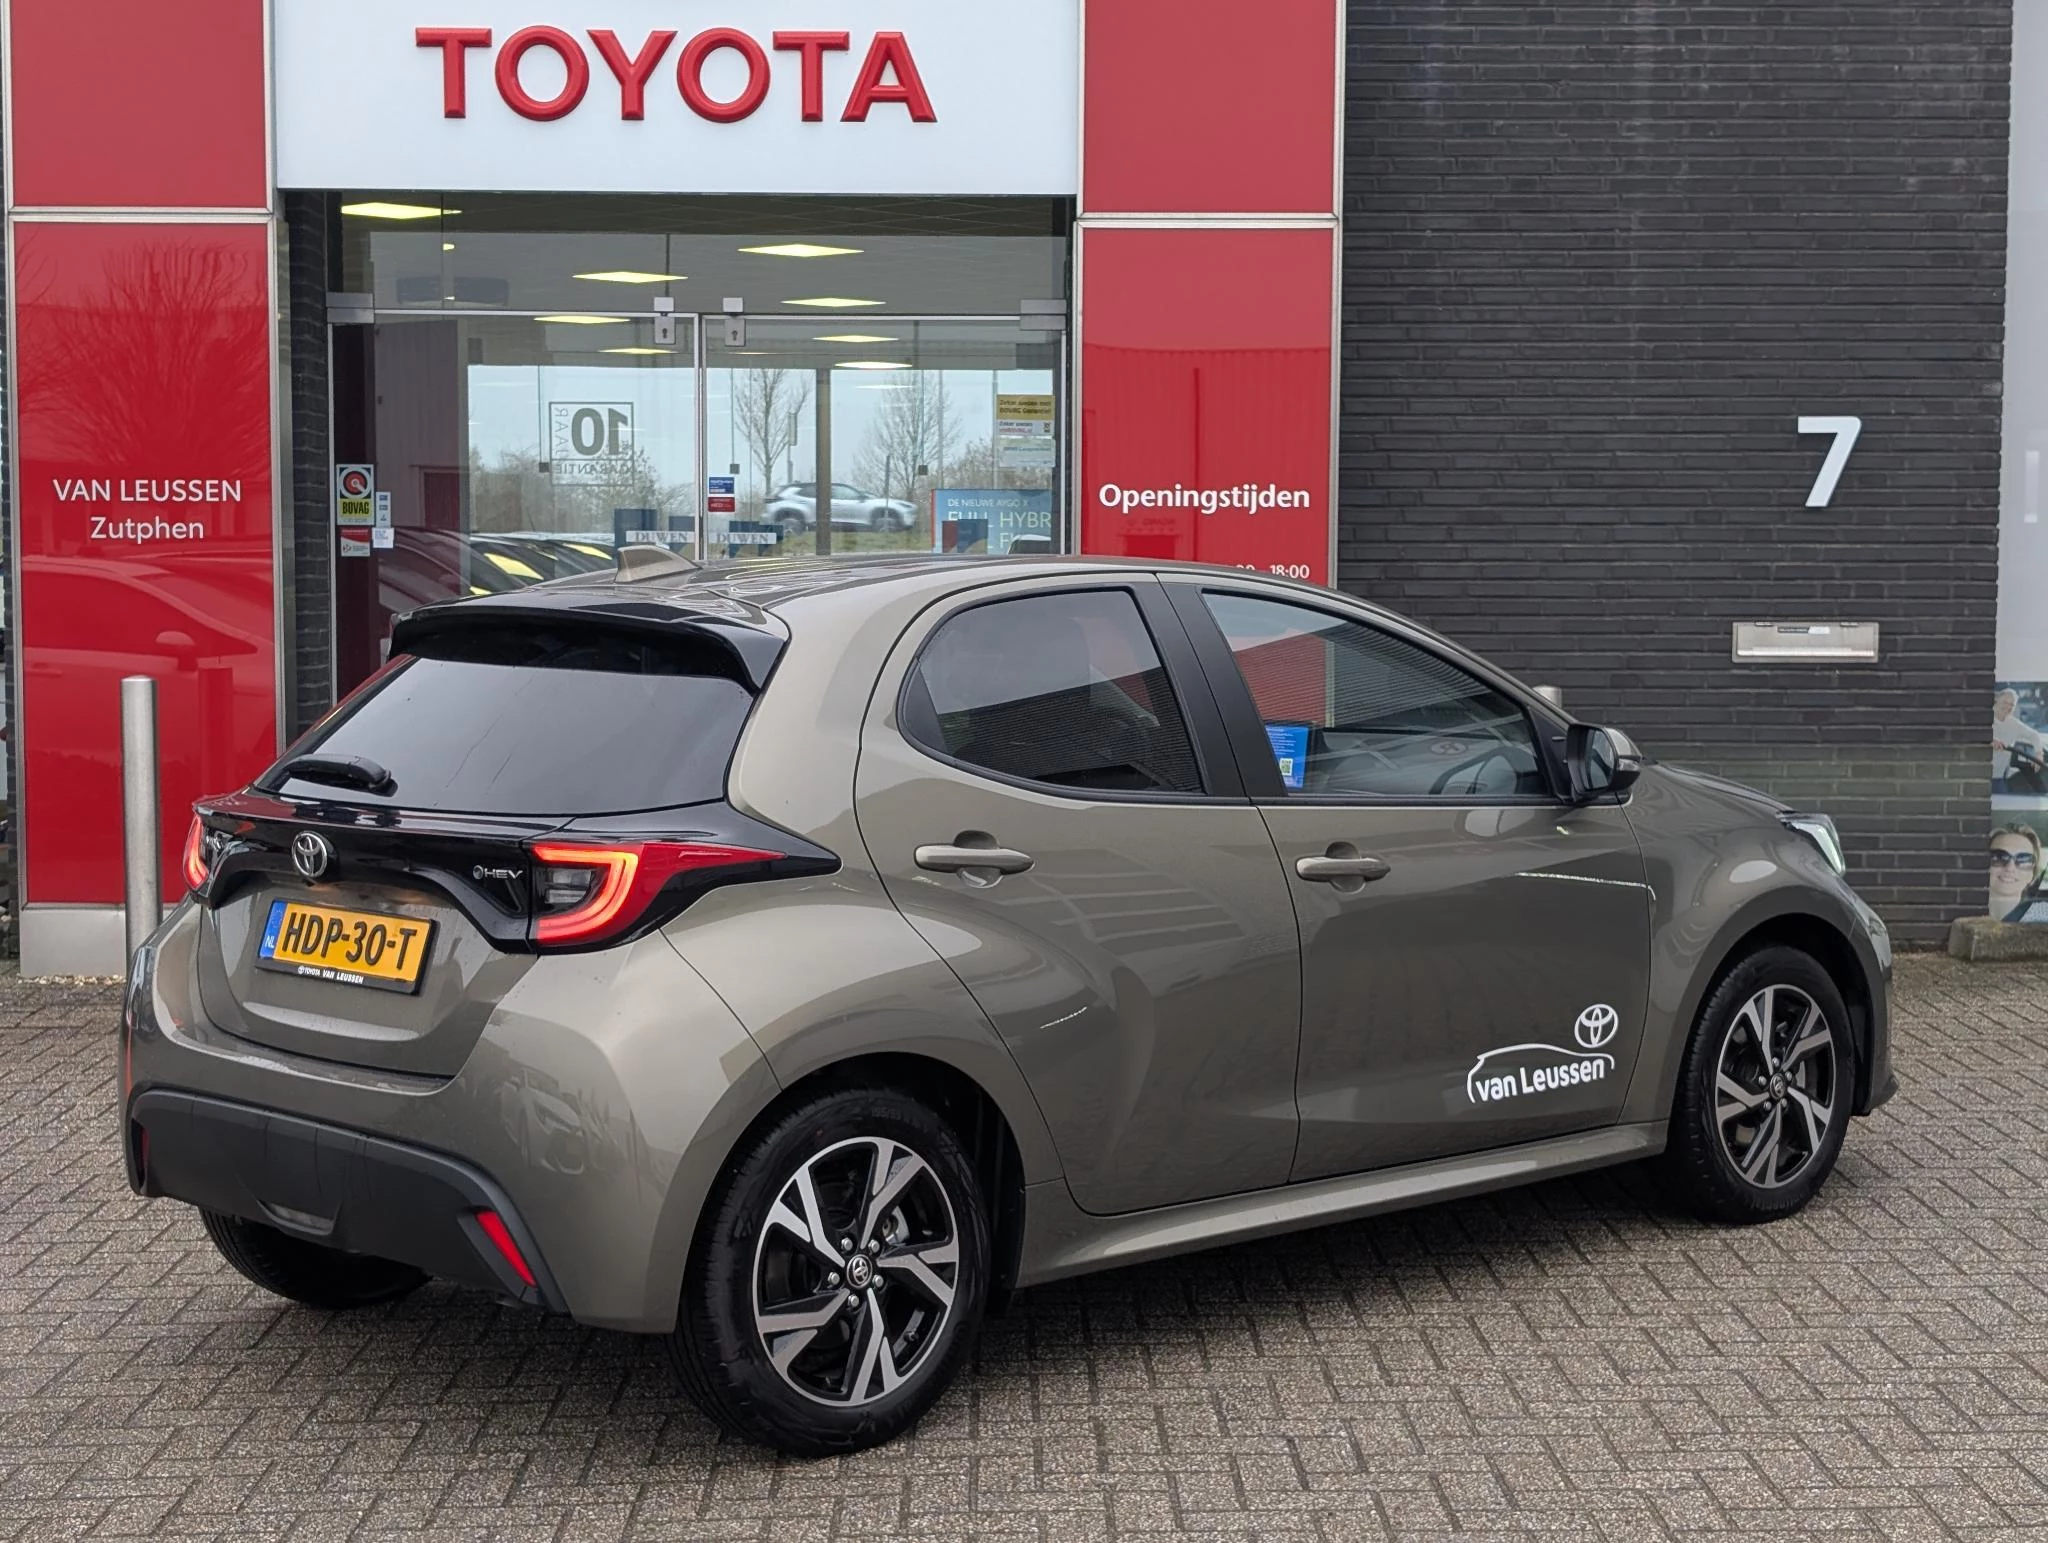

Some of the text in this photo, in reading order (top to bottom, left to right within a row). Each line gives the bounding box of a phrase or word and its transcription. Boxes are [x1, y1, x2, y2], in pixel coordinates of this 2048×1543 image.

[415, 25, 938, 124] TOYOTA
[1797, 415, 1862, 507] 7
[53, 479, 242, 502] VAN LEUSSEN
[947, 499, 959, 508] DE
[1099, 483, 1310, 515] Openingstijden
[342, 501, 371, 515] BOVAG
[90, 515, 204, 544] Zutphen
[635, 532, 688, 543] DUWEN
[716, 533, 769, 544] DUWEN
[1270, 564, 1310, 579] 18:00
[484, 867, 523, 879] HEV
[265, 935, 275, 949] NL
[281, 911, 418, 971] HDP-30-T
[322, 969, 335, 980] VAN
[336, 971, 364, 984] LEUSSEN
[1475, 1058, 1605, 1102] van Leussen
